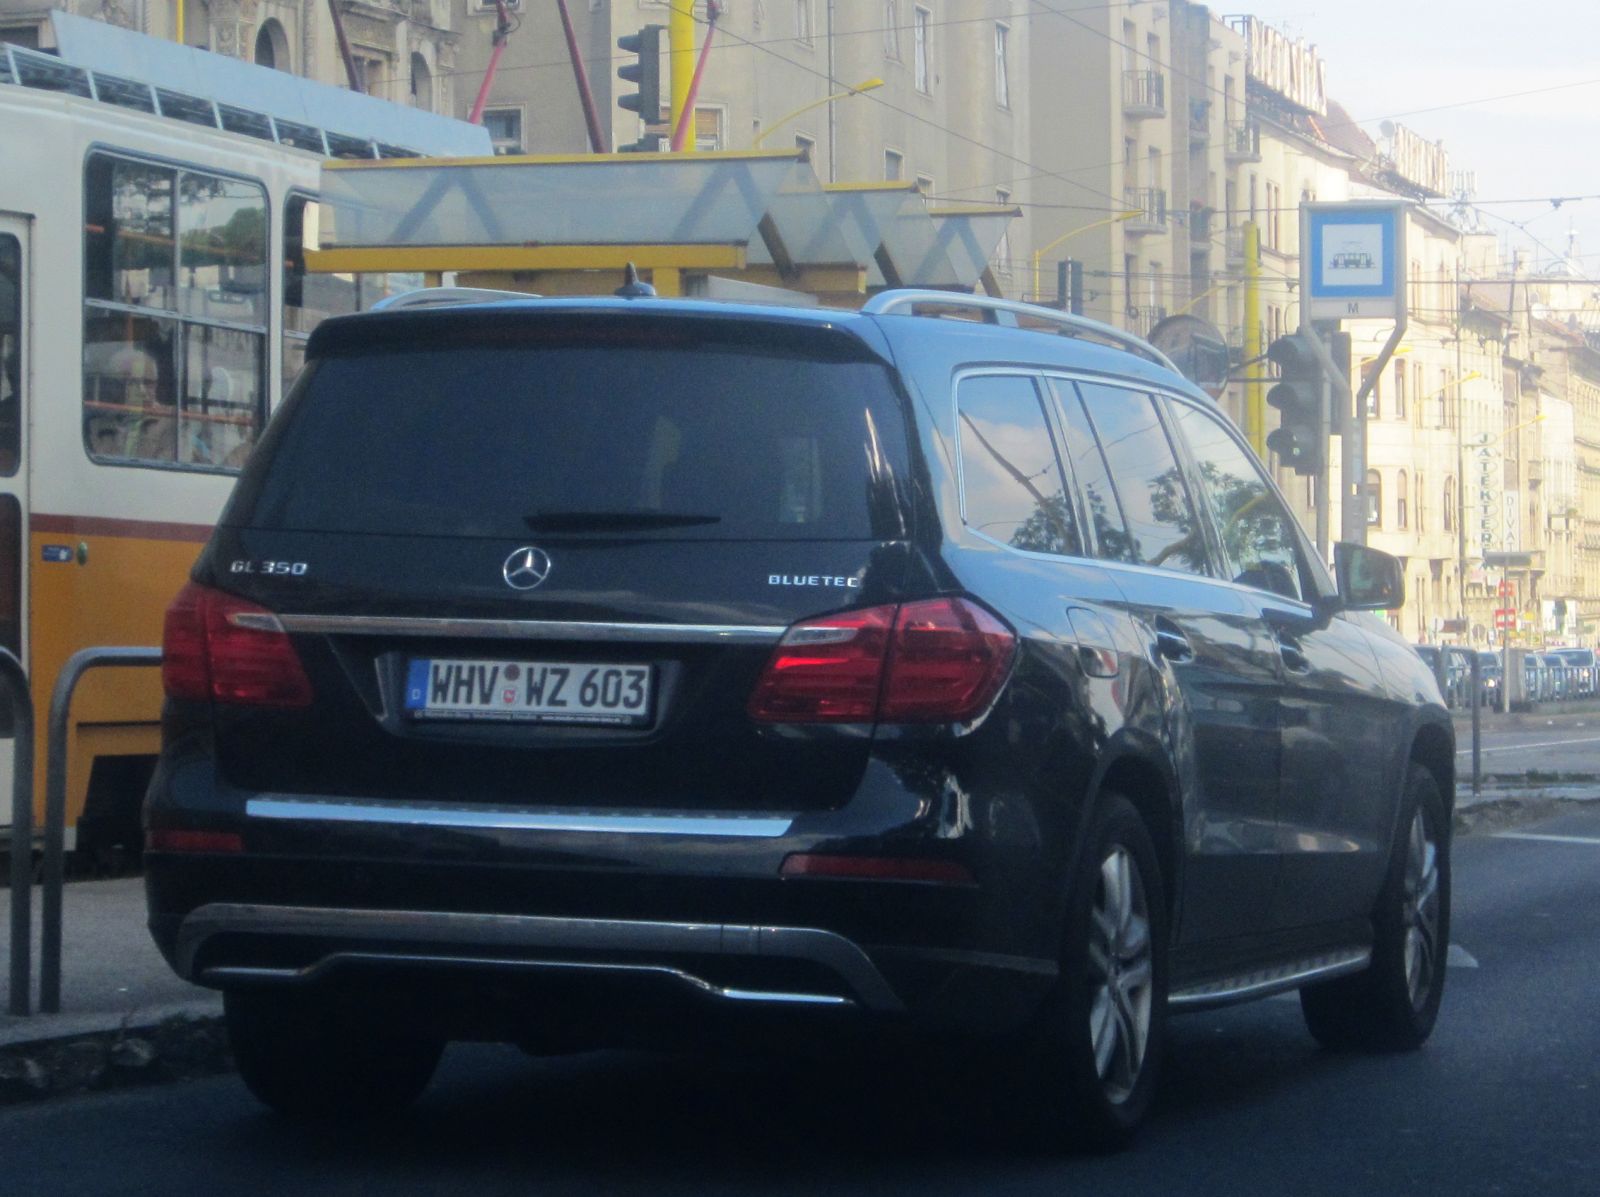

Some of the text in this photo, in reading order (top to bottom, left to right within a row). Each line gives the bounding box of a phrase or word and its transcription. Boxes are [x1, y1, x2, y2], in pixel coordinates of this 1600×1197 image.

[1347, 302, 1359, 313] M
[230, 560, 307, 575] GL 350
[768, 575, 857, 588] BLUETEC
[431, 665, 647, 709] WHV WZ 603
